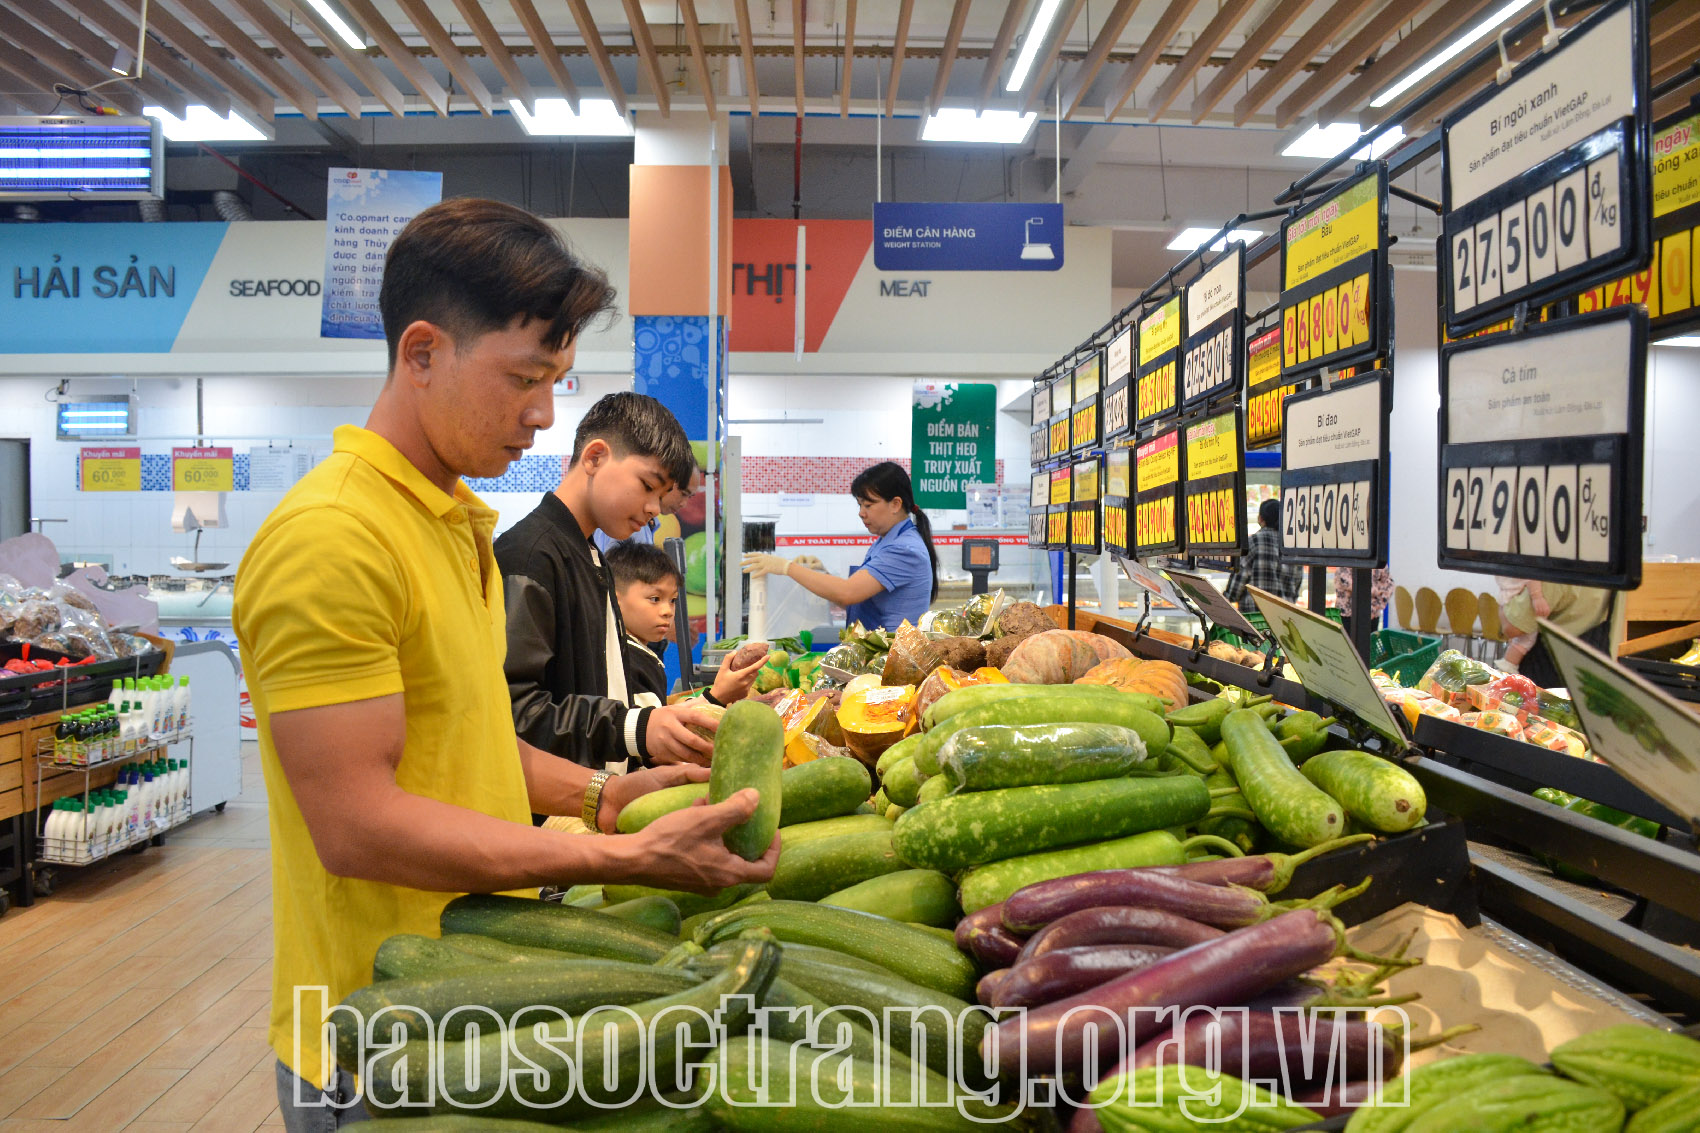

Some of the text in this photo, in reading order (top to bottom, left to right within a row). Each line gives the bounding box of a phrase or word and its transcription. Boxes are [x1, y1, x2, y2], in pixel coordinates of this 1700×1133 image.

[1490, 82, 1558, 137] Bí ngòi xanh
[1481, 146, 1500, 168] phẩm
[1514, 129, 1528, 145] tiêu
[1529, 113, 1553, 136] chuẩn
[1553, 92, 1588, 121] VietGAP
[1655, 125, 1692, 153] ngày
[1655, 176, 1698, 202] tiêu chuẩn
[334, 226, 355, 235] kinh
[359, 226, 389, 236] doanh
[883, 225, 976, 238] ĐIỂM CÂN HÀNG
[1457, 187, 1577, 291] 27.500
[333, 238, 358, 249] hàng
[13, 254, 175, 298] HẢI SẢN
[332, 263, 357, 274] vùng
[229, 280, 321, 297] SEAFOOD
[361, 290, 375, 298] tra
[880, 279, 932, 297] MEAT
[1286, 292, 1350, 355] 26.800
[927, 418, 979, 438] ĐIỂM BÁN
[929, 441, 977, 458] THỊT HEO
[923, 456, 982, 475] TRUY XUẤT
[920, 474, 958, 493] NGUỒN
[1286, 489, 1350, 537] 23.500
[1452, 476, 1571, 545] 22.900
[807, 537, 831, 545] TOÀN
